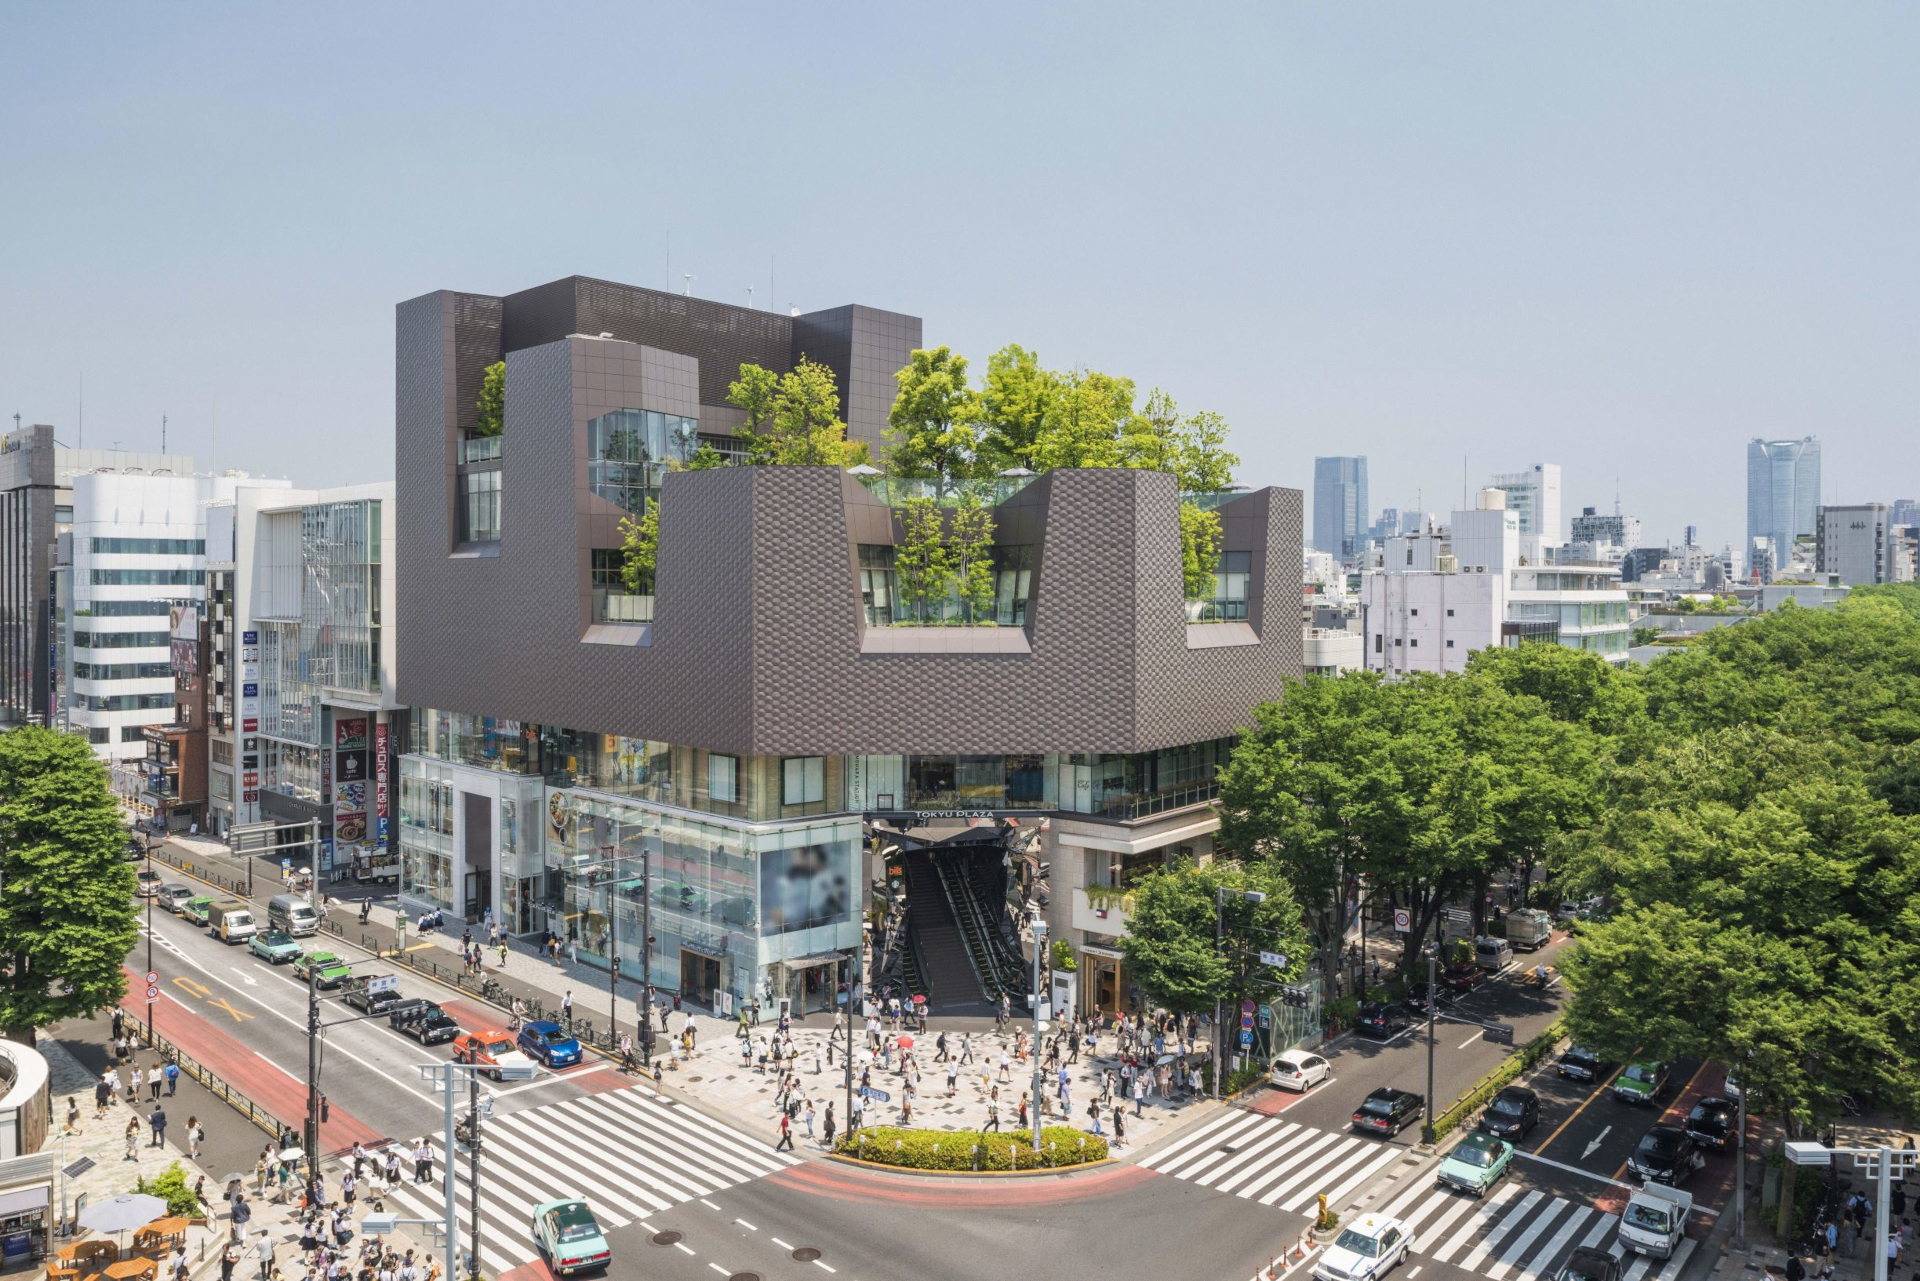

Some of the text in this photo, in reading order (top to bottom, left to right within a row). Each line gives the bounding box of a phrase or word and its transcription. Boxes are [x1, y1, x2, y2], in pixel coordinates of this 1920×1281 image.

[377, 737, 387, 803] チュロス専門店
[380, 818, 388, 829] P
[1242, 1033, 1249, 1042] P
